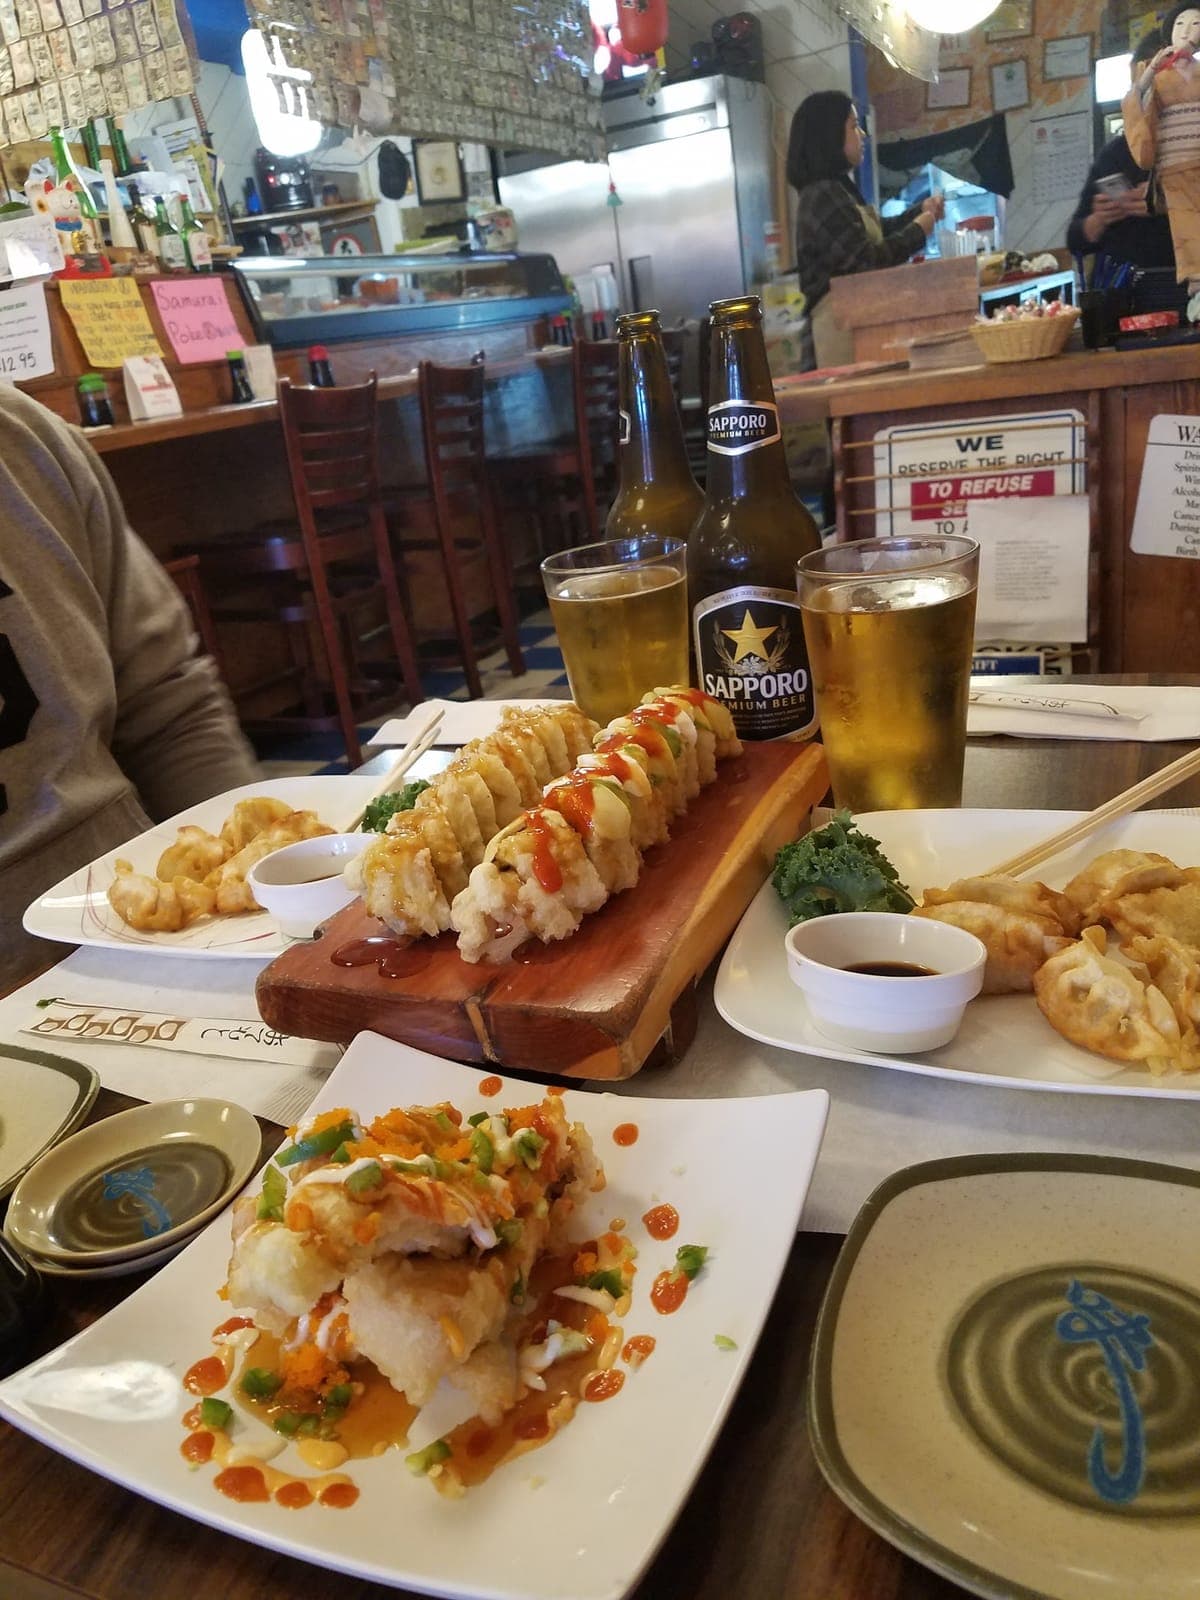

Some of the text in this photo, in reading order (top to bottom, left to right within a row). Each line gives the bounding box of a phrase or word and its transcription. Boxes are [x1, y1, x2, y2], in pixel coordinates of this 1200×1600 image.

[157, 284, 223, 311] Samurai
[709, 414, 767, 432] SAPPORO
[956, 434, 1004, 453] WE
[899, 450, 1065, 476] RESERVE THE RIGHT
[928, 474, 1034, 499] TO REFUSE
[935, 520, 955, 535] TO
[973, 660, 998, 671] IFT
[705, 668, 808, 700] SAPPORO
[772, 694, 806, 708] BEER
